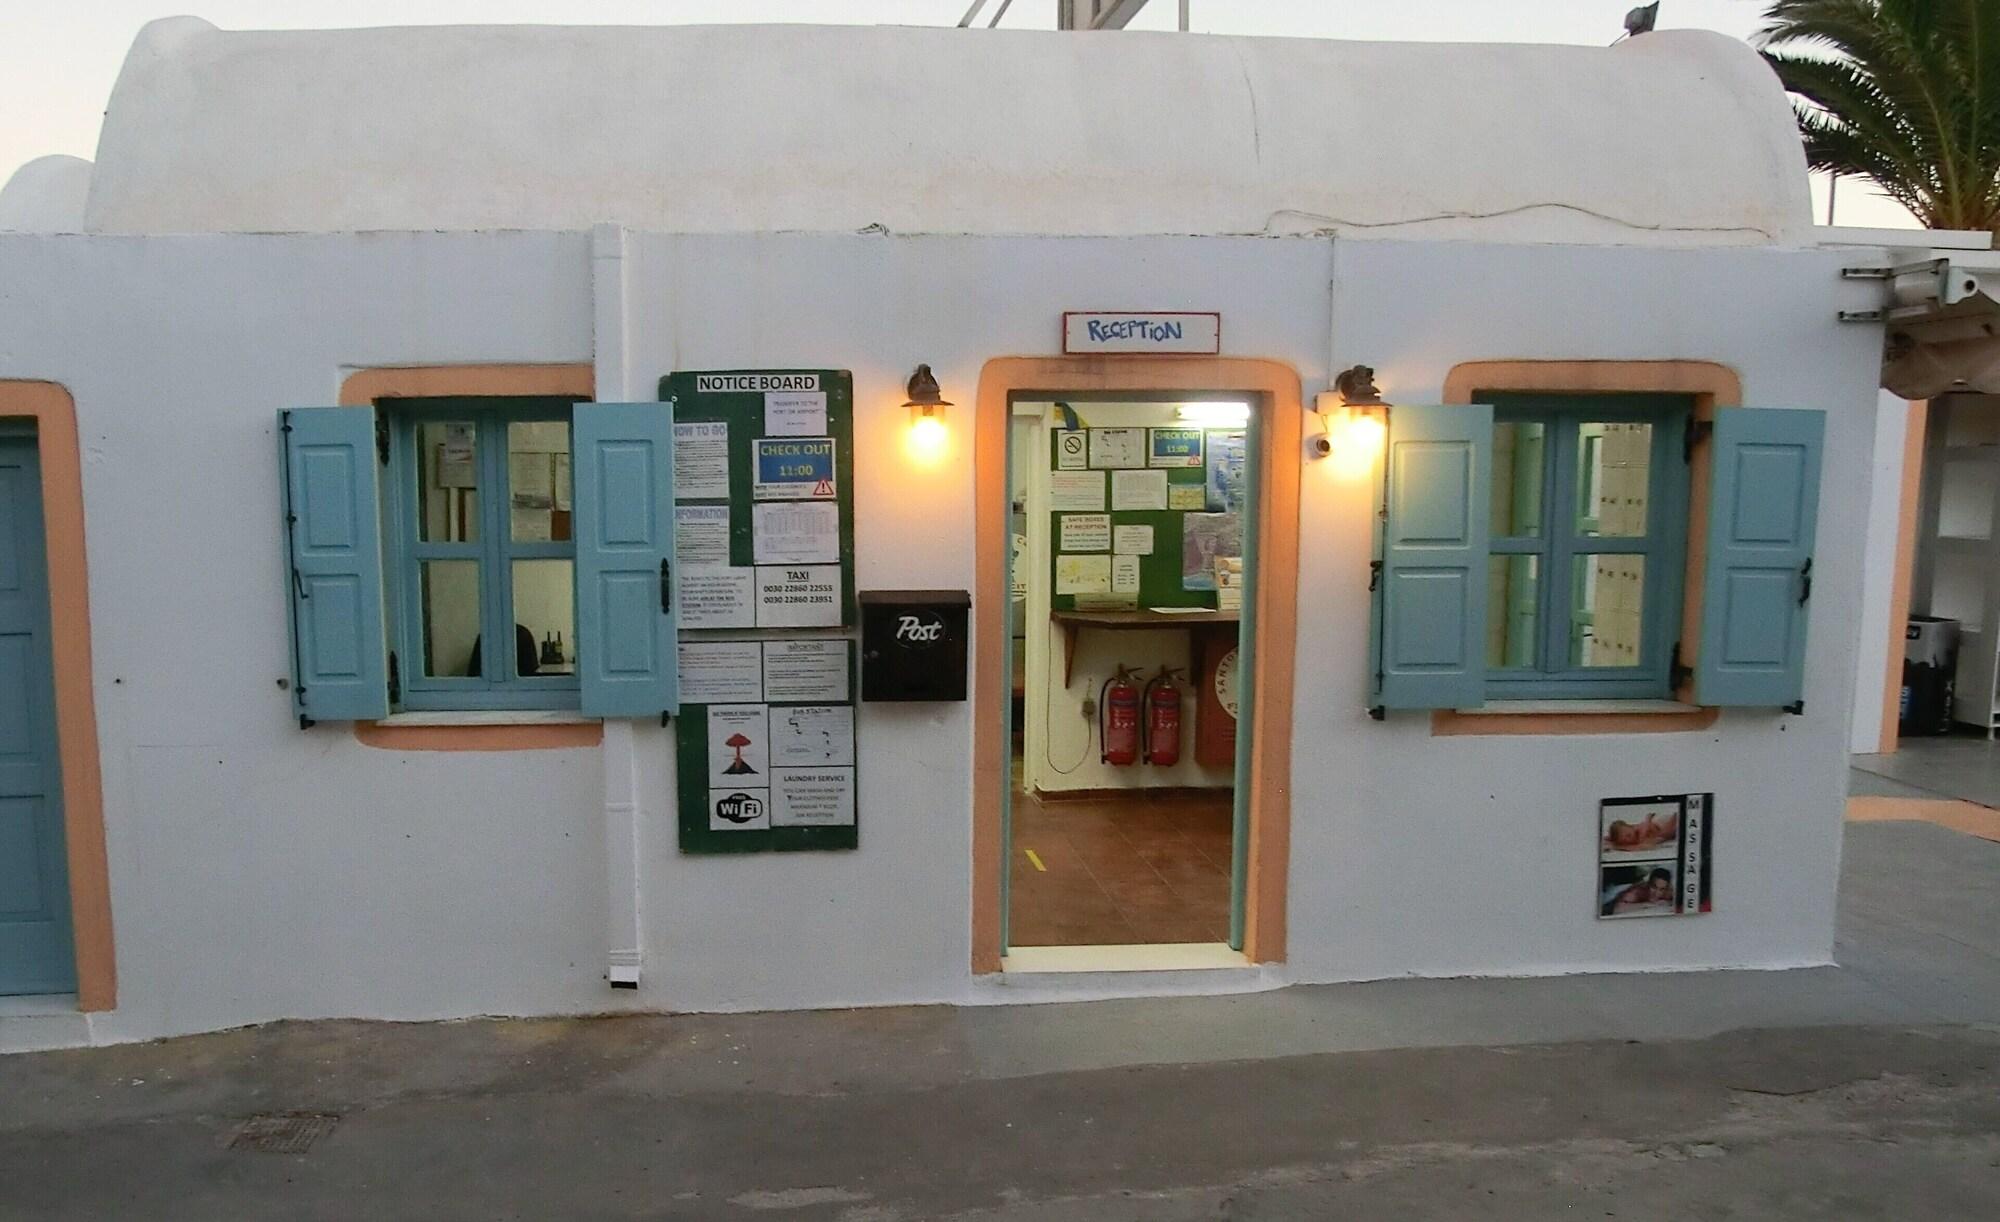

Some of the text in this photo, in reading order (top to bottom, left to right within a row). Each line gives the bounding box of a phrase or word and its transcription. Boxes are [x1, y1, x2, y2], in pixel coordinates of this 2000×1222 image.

[700, 376, 815, 390] NOTICE BOARD
[760, 444, 831, 456] CHECK OUT
[780, 465, 814, 476] 11:00
[786, 571, 809, 580] TAXI
[763, 584, 783, 593] 0030
[809, 584, 833, 592] 22555
[763, 595, 783, 604] 0030
[896, 615, 942, 641] Post
[783, 775, 845, 783] LAUNDRY SERVICE
[1686, 800, 1699, 909] MASSAGE
